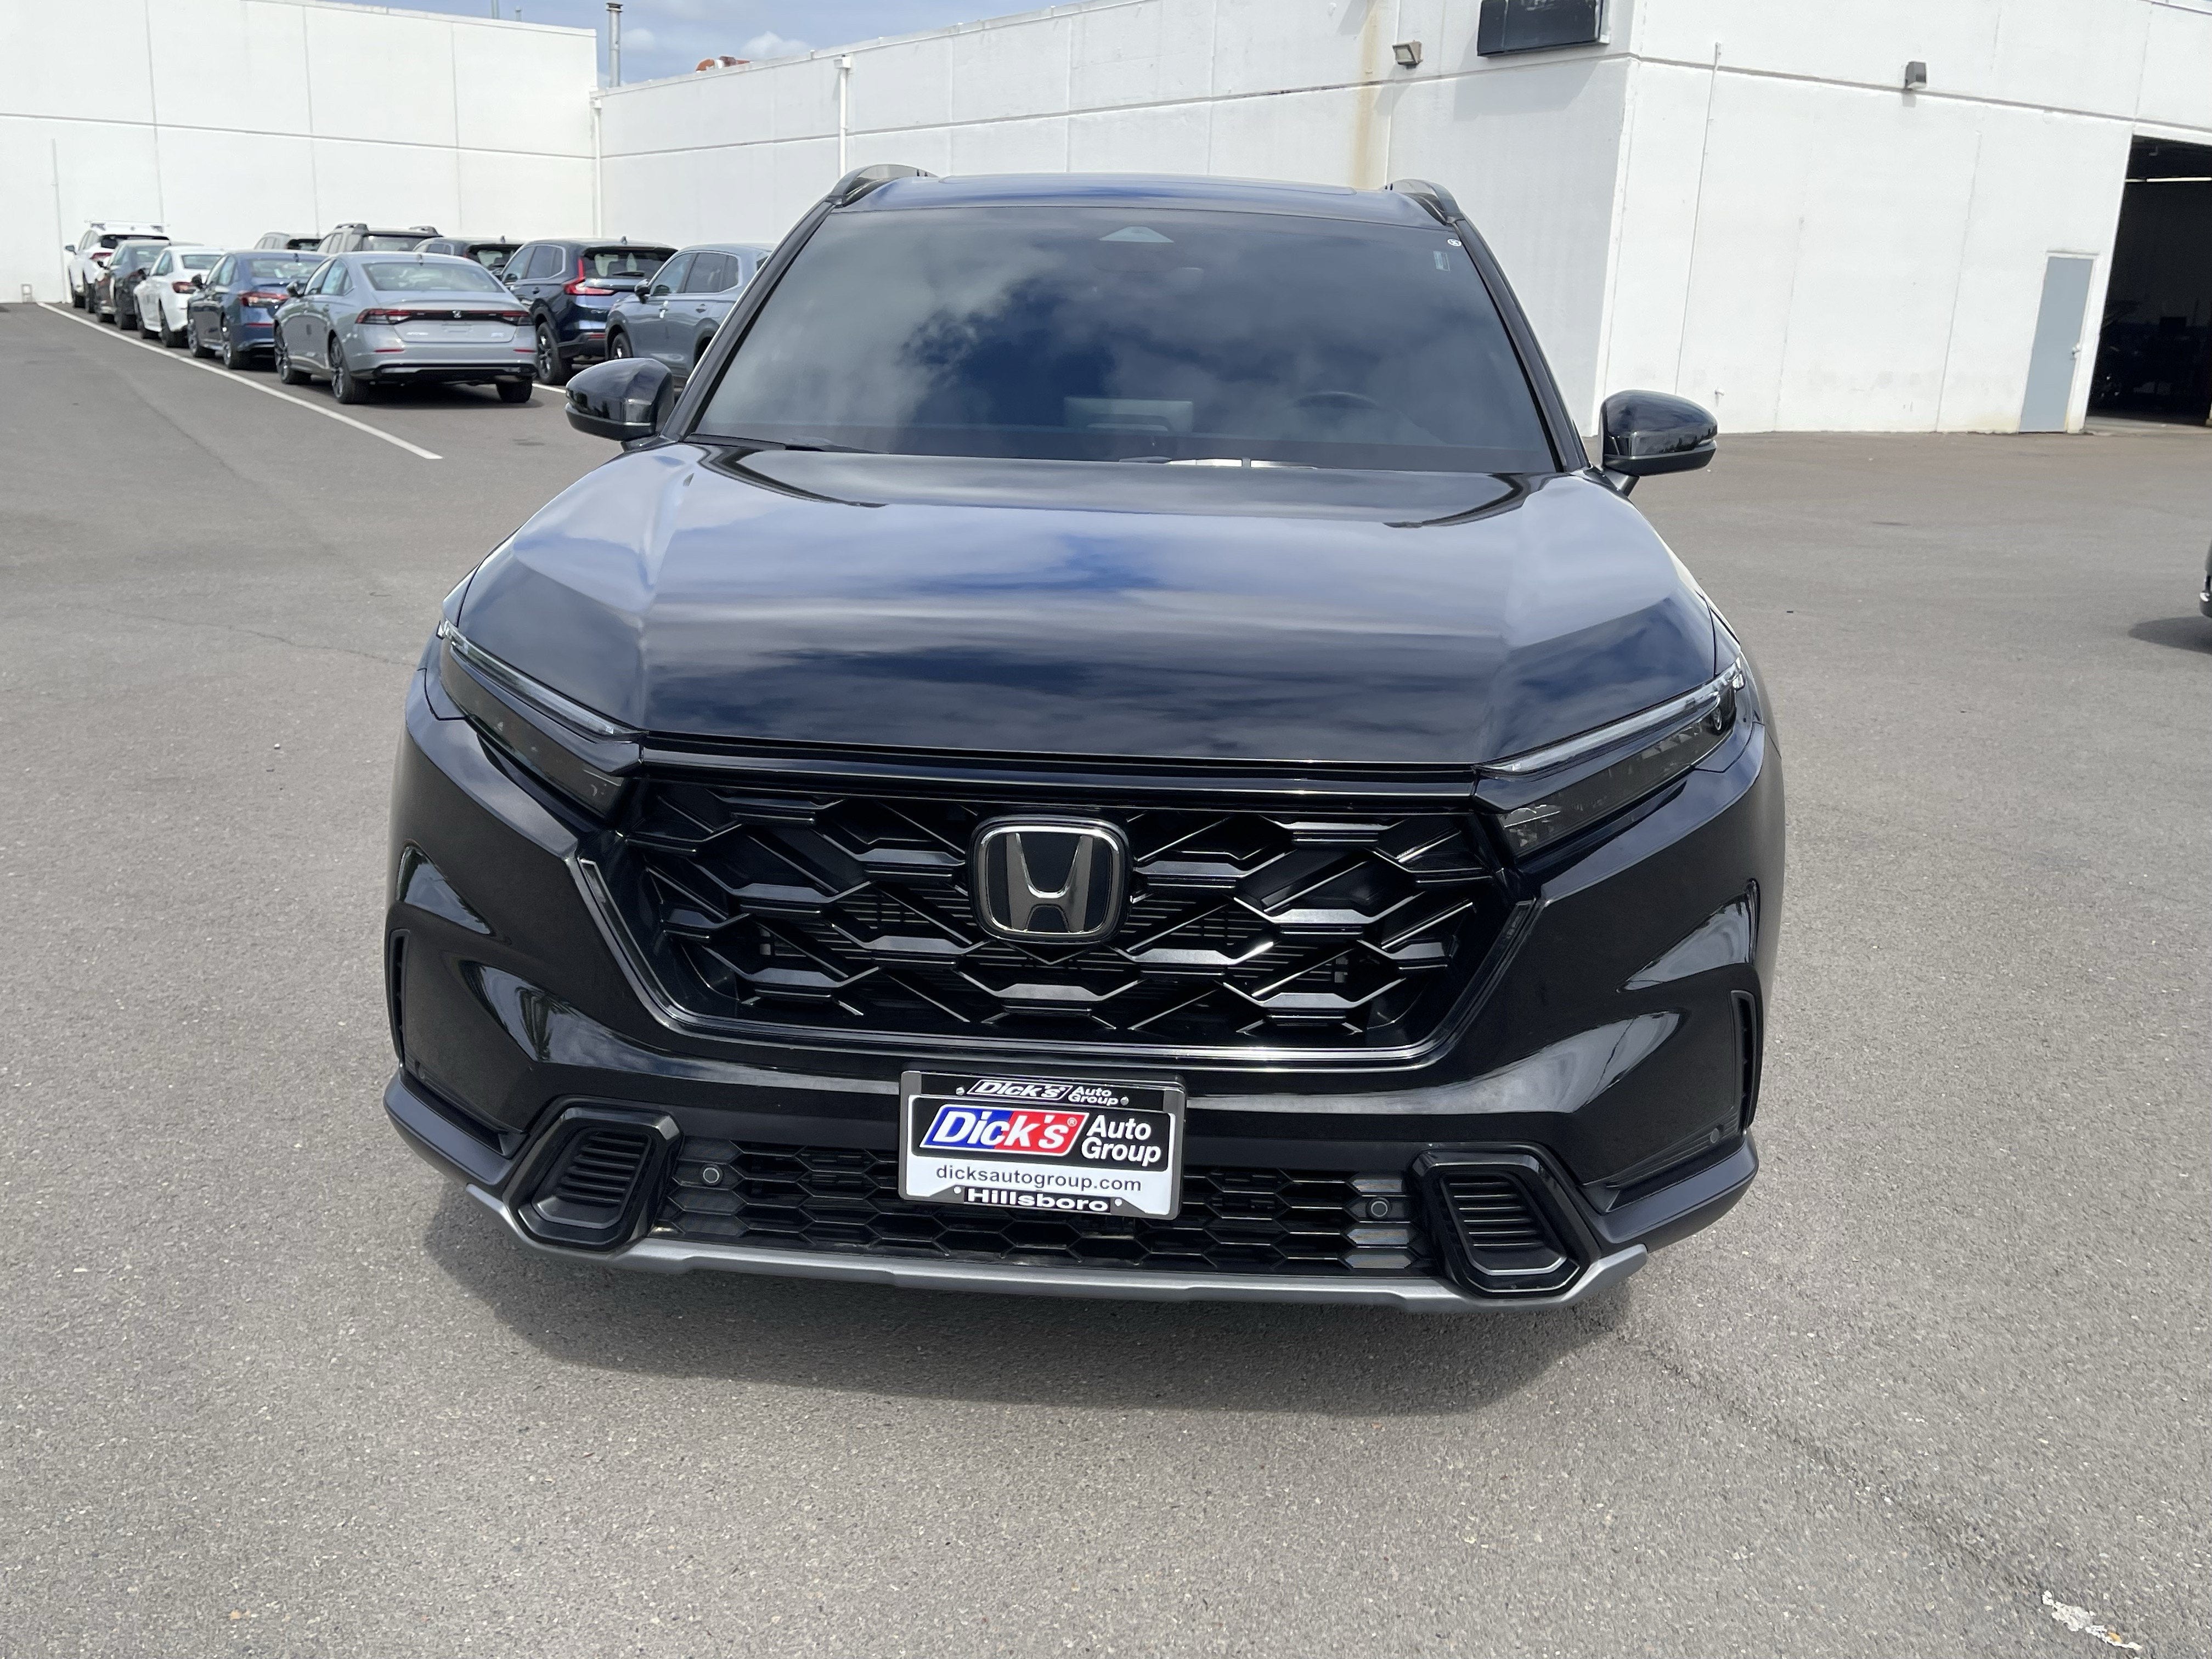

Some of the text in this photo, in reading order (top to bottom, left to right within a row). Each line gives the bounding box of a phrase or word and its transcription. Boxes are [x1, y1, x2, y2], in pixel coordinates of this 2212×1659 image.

[1068, 1093, 1119, 1106] Group
[1073, 1086, 1112, 1097] Auto
[1086, 1115, 1152, 1141] Auto
[1081, 1136, 1161, 1167] Group
[936, 1164, 1142, 1192] dicksautogroup.com
[967, 1188, 1109, 1212] Hillsboro
